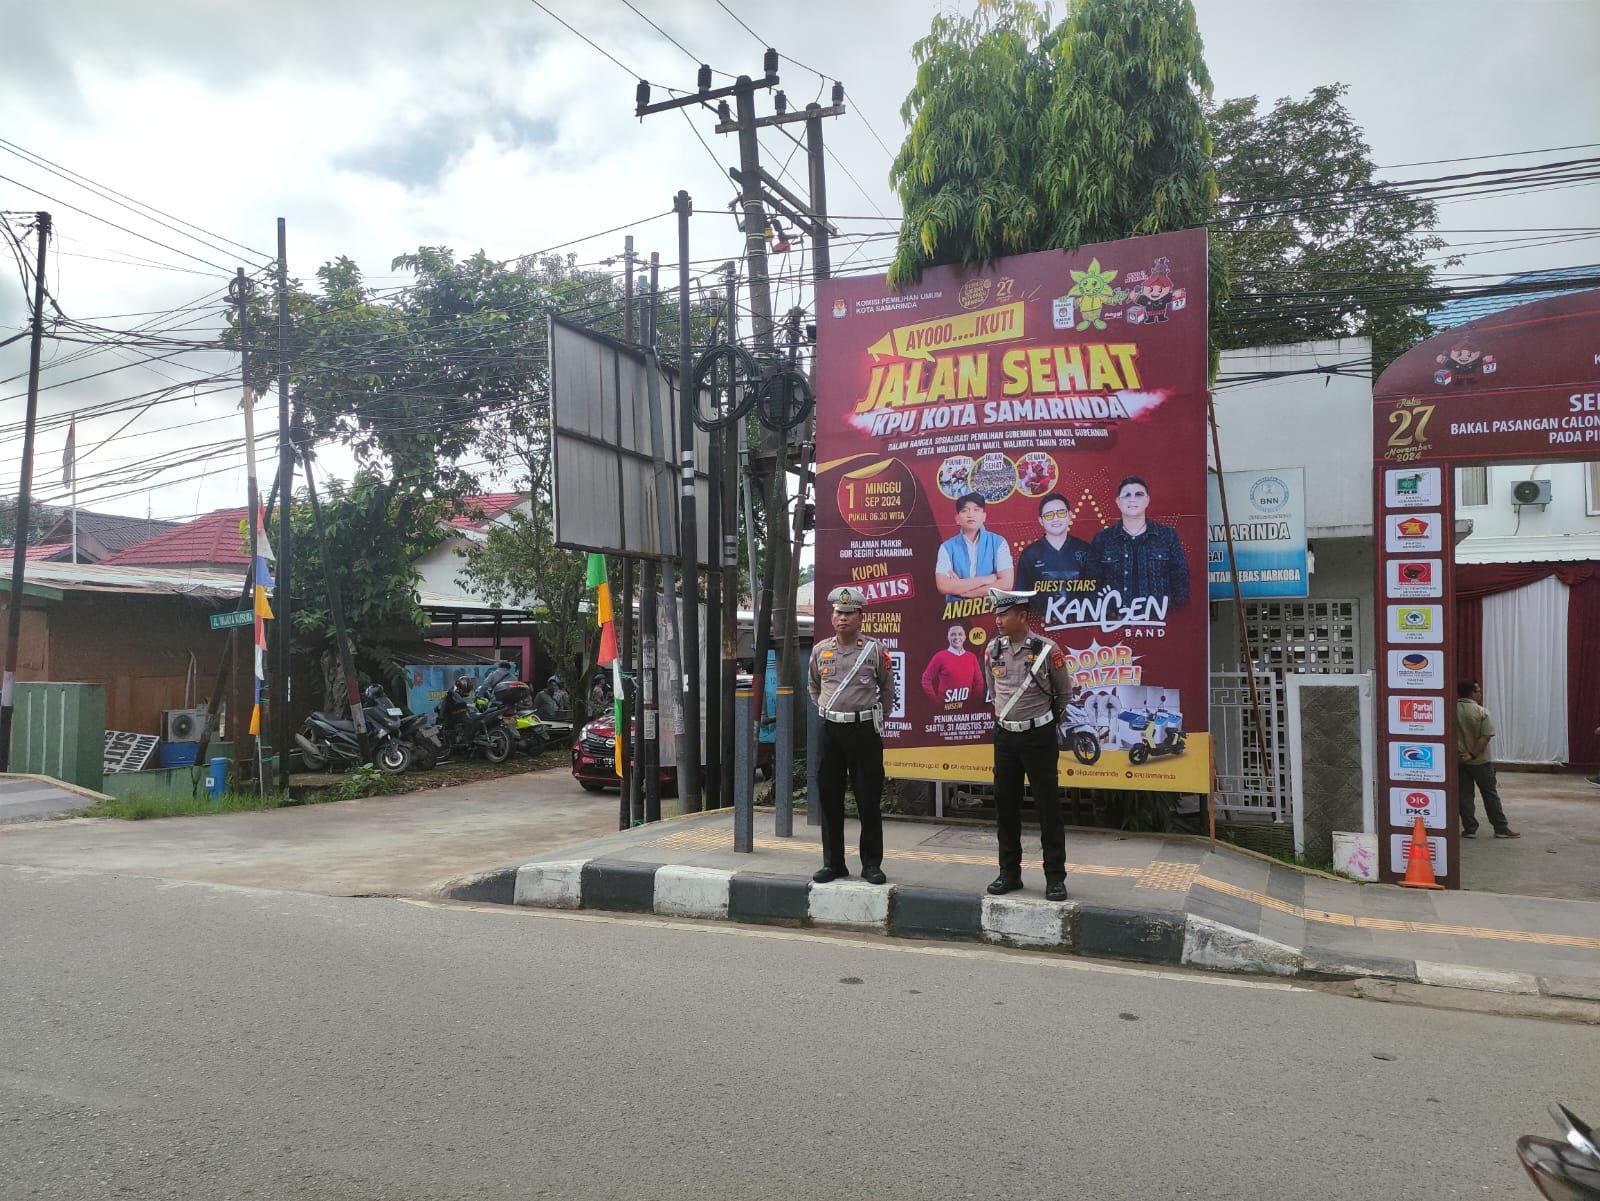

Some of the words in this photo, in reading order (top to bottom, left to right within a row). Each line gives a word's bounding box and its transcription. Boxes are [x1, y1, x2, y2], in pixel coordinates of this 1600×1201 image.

[855, 298, 881, 308] KOMISI
[881, 295, 919, 305] PEMILIHAN
[920, 291, 943, 300] UMUM
[855, 306, 875, 314] KOTA
[876, 302, 918, 312] SAMARINDA
[855, 353, 988, 413] JALAN
[1002, 343, 1142, 396] SEHAT
[872, 410, 917, 437] KPU
[920, 403, 979, 429] KOTA
[984, 395, 1130, 422] SAMARINDA
[1387, 404, 1436, 446] 27
[1450, 422, 1490, 435] BAKAL
[1492, 417, 1559, 433] PASANGAN
[887, 443, 909, 452] DALAM
[909, 438, 933, 448] RANGKA
[934, 434, 969, 445] SOSIALISASI
[970, 428, 1004, 441] PEMILIHAN
[1005, 429, 1037, 438] GUBERNUR
[1038, 429, 1052, 437] DAN
[1053, 428, 1074, 437] WAKIL
[1074, 428, 1109, 437] GUBERNUR
[1548, 430, 1583, 444] PADA
[916, 447, 935, 456] SERTA
[936, 443, 966, 454] WALIKOTA
[967, 442, 980, 451] DAN
[982, 440, 1001, 449] WAKIL
[1003, 439, 1034, 448] WALIKOTA
[1036, 438, 1057, 447] TAHUN
[1058, 438, 1076, 447] 2024
[1384, 443, 1433, 459] November
[984, 453, 1003, 462] JALAN
[1396, 452, 1422, 463] 2024
[984, 462, 1004, 470] SEHAT
[865, 481, 902, 495] MINGGU
[845, 482, 855, 509] 1
[865, 496, 880, 507] SEP
[881, 495, 901, 507] 2024
[1260, 497, 1279, 505] BNN
[848, 513, 869, 521] PUKUL
[869, 512, 888, 521] 06.30
[889, 511, 905, 520] WITA
[1208, 521, 1291, 542] AMARINDA
[850, 540, 879, 549] HALAMAN
[880, 539, 902, 548] PARKIR
[839, 549, 853, 558] GOR
[853, 549, 874, 558] SEGIRI
[875, 547, 913, 557] SAMARINDA
[851, 562, 889, 581] KUPON
[1238, 570, 1260, 582] EBAS
[1260, 569, 1301, 582] NARKOBA
[1034, 580, 1065, 592] GUEST
[1066, 579, 1097, 592] STARS
[862, 612, 902, 623] DAFTARAN
[1044, 589, 1169, 633] KANGEN
[873, 622, 901, 633] SANTAI
[1125, 628, 1166, 638] BAND
[1065, 645, 1133, 673] DOOR
[1069, 665, 1142, 689] RIZE!
[944, 687, 970, 702] SAID
[1413, 701, 1433, 712] Partai
[933, 713, 970, 724] PENUKARAN
[970, 712, 992, 721] KUPON
[1413, 711, 1433, 720] Buruh
[884, 721, 913, 730] PERTAMA
[947, 723, 954, 731] 31
[955, 721, 982, 731] AGUSTUS
[983, 721, 996, 730] 202
[1405, 808, 1431, 816] PKS
